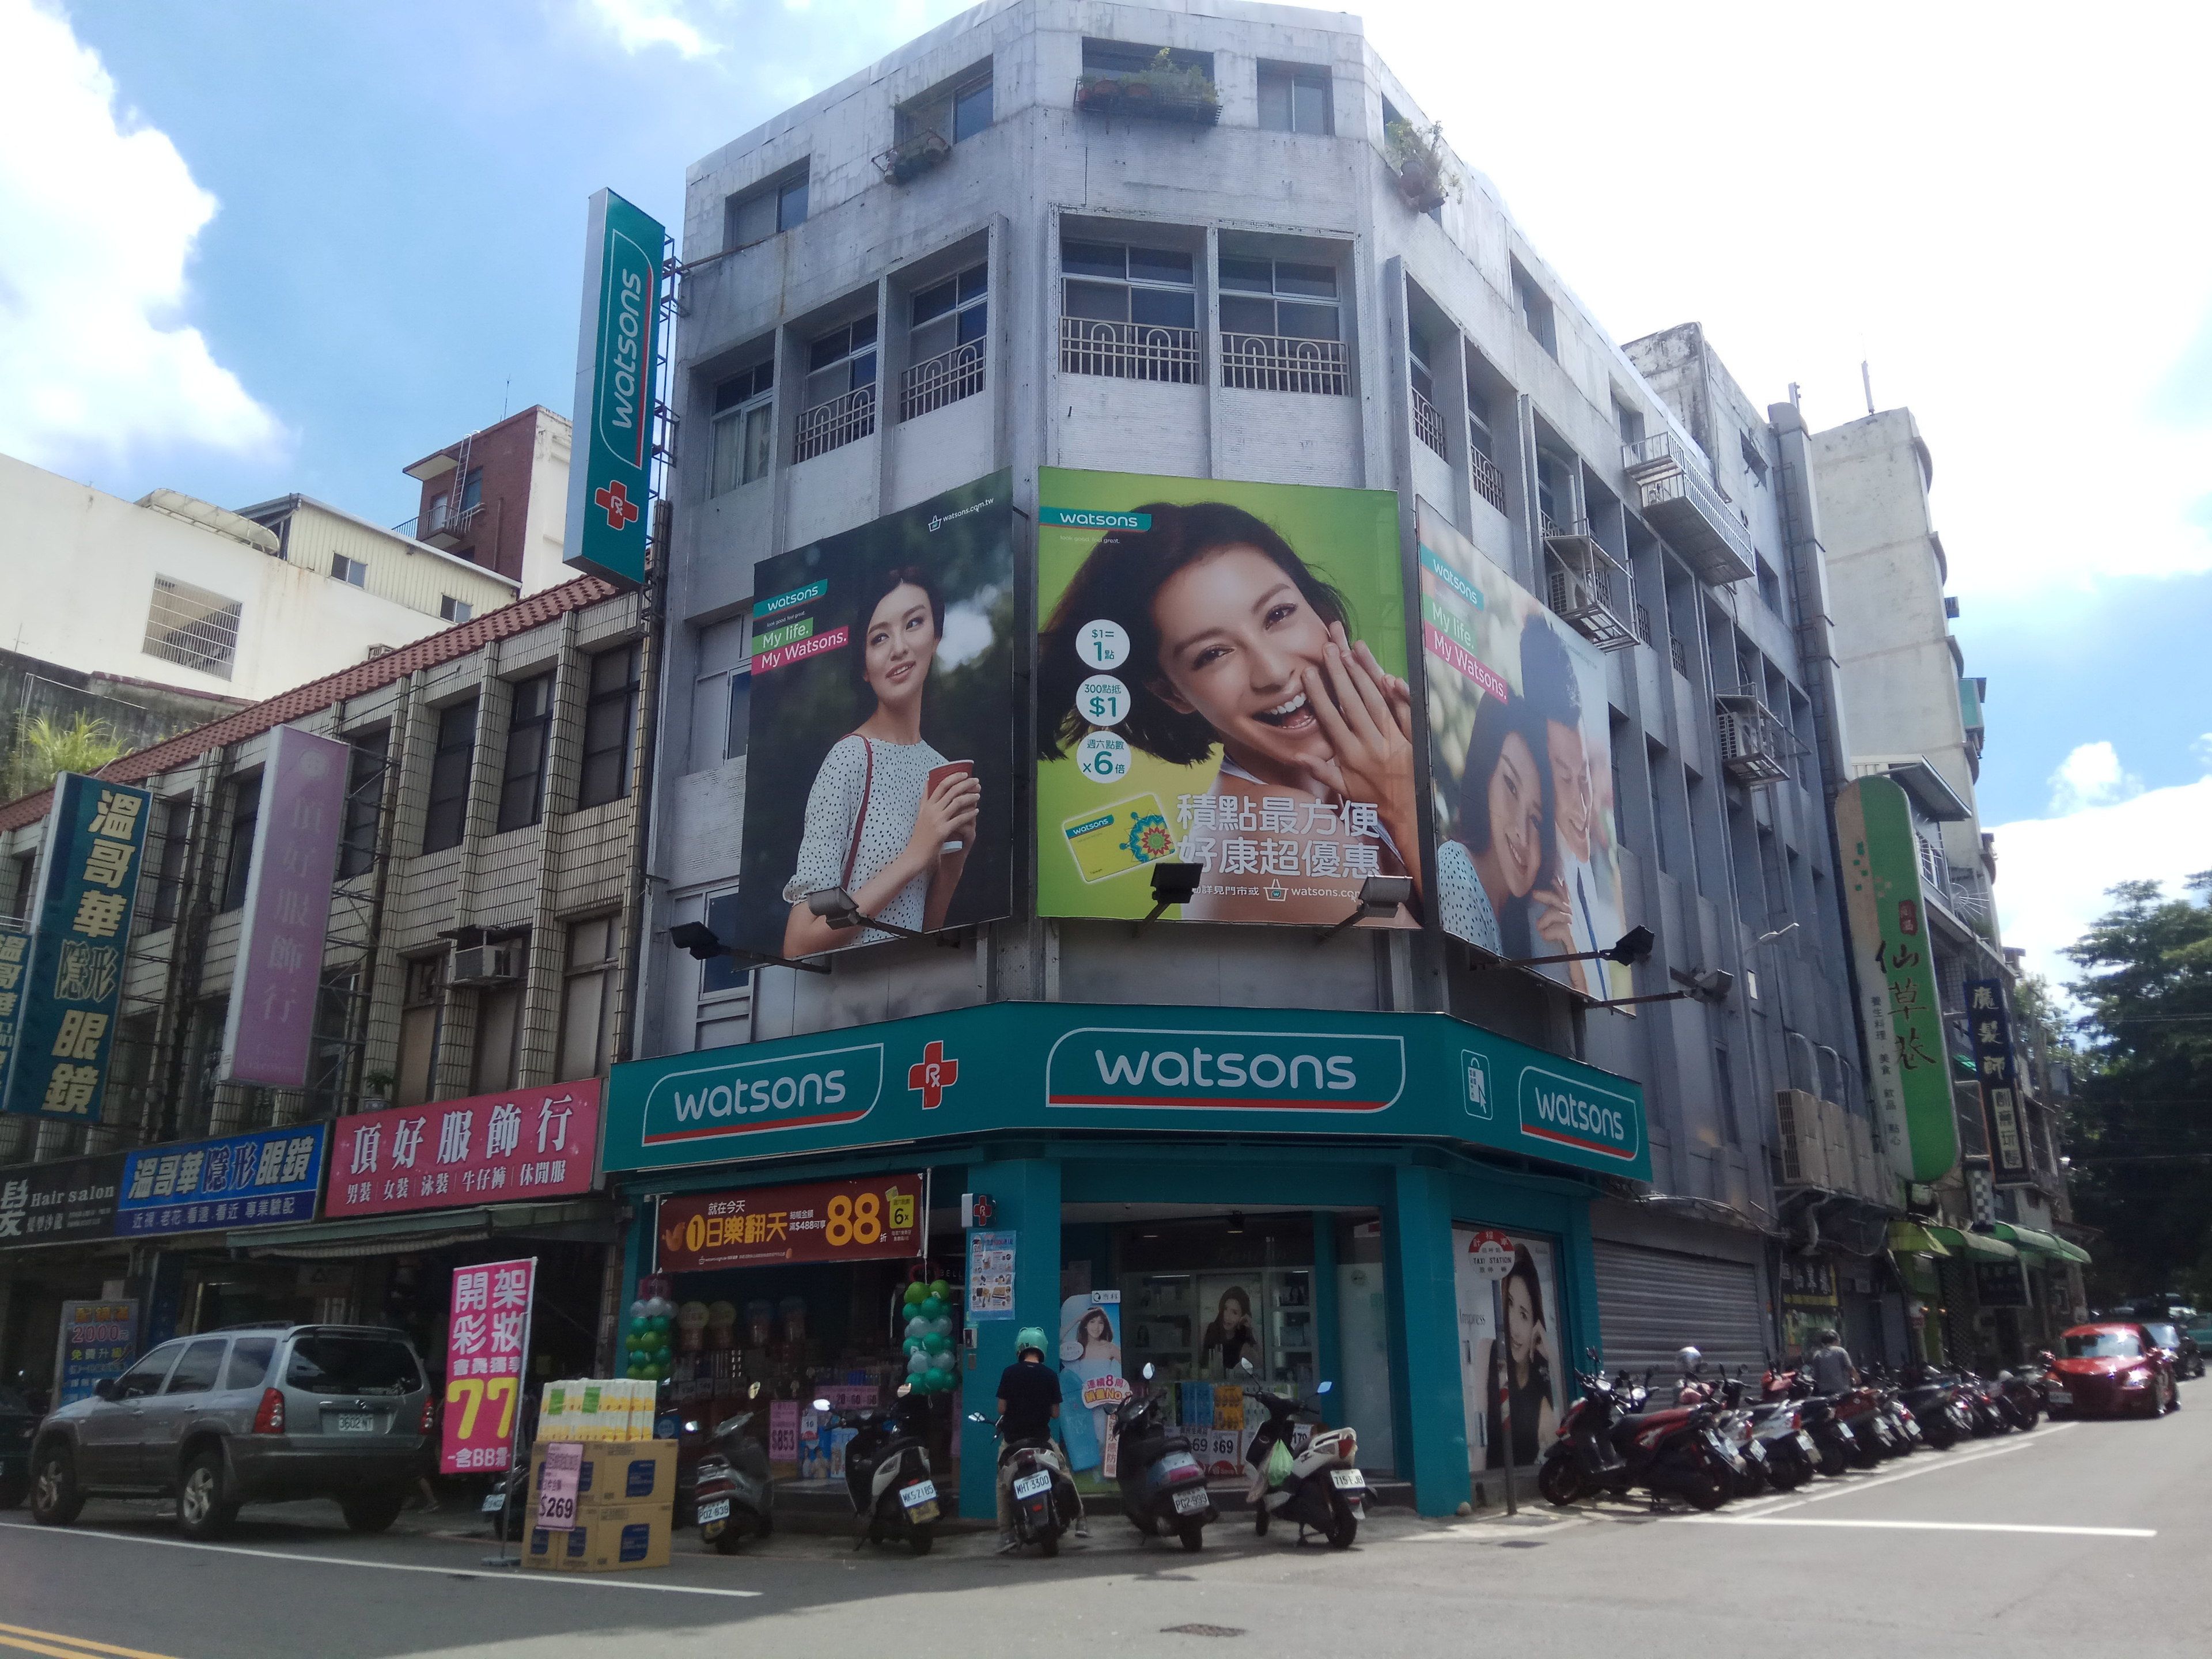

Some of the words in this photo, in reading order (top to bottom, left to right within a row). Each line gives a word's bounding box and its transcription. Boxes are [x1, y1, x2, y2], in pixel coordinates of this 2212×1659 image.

[612, 268, 641, 429] watsons
[942, 498, 994, 522] watsons.com.tw
[1060, 512, 1138, 527] watsons
[767, 585, 819, 611] watsons
[1432, 558, 1478, 605] watsons
[763, 631, 782, 649] My
[786, 623, 809, 641] life.
[1432, 601, 1450, 632] My
[1453, 618, 1475, 650] life.
[761, 652, 781, 669] My
[785, 632, 847, 661] Watsons.
[1434, 630, 1452, 662] My
[1456, 646, 1507, 700] Watsons.
[1085, 684, 1122, 694] 300點抵
[1089, 696, 1116, 717] $1
[1087, 740, 1124, 749] 週六點數
[1073, 818, 1109, 835] watsons
[1176, 793, 1380, 839] 積點最方便
[1176, 835, 1380, 880] 好康超優惠
[1095, 1047, 1357, 1090] watsons
[674, 1069, 846, 1122] watsons
[1535, 1087, 1624, 1141] watsons
[350, 1094, 573, 1175] 頂好服飾行
[30, 1190, 65, 1207] Hair
[68, 1185, 115, 1203] salon
[346, 1181, 372, 1205] 男裝
[382, 1177, 410, 1201] 女裝
[420, 1172, 449, 1197] 泳裝
[461, 1166, 507, 1192] 牛仔褲
[708, 1200, 745, 1215] 就在今天
[825, 1192, 881, 1247] 88
[455, 1269, 527, 1313] 開架
[452, 1311, 524, 1355] 彩妝
[448, 1377, 519, 1440] 77
[1213, 1440, 1234, 1454] $69
[539, 1494, 574, 1519] $269
